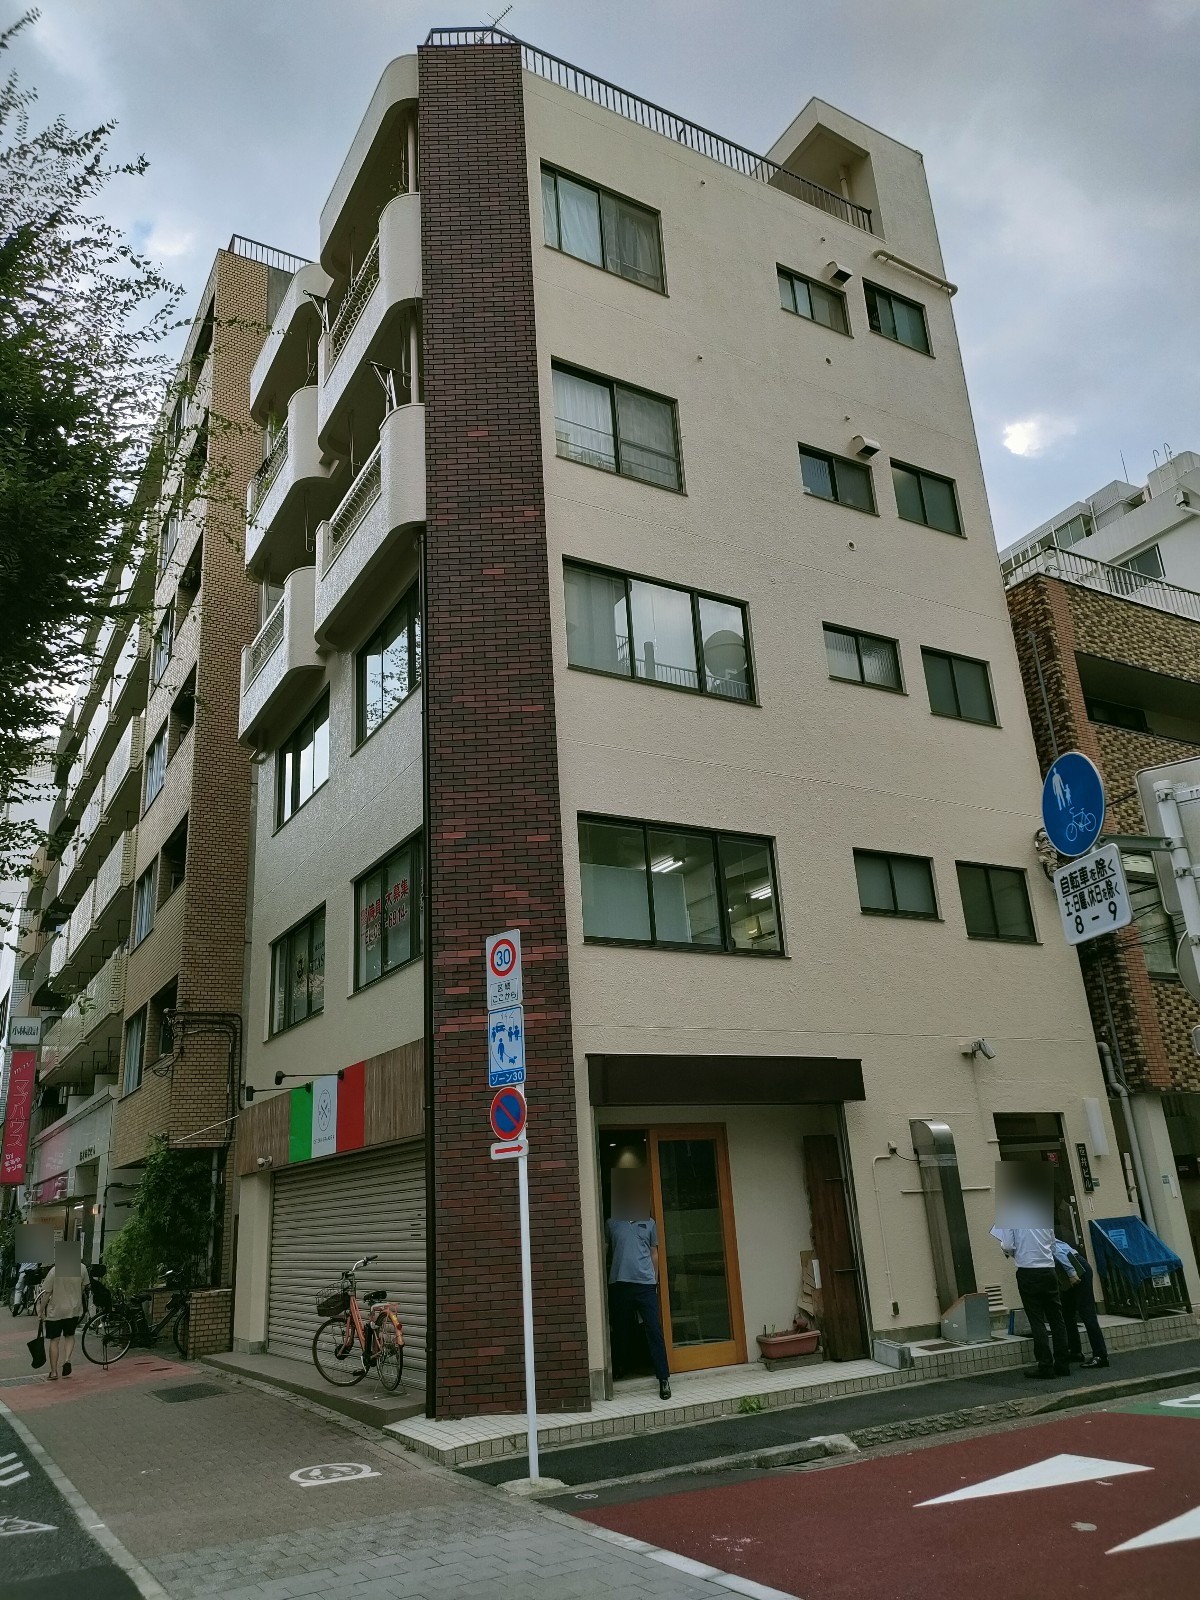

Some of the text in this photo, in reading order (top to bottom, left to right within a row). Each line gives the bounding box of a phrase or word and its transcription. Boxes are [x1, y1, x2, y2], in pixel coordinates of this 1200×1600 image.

[1060, 858, 1115, 895] 自転車を除く
[496, 948, 511, 967] 30
[493, 991, 516, 1003] ここから
[491, 1070, 523, 1085] ゾーン30
